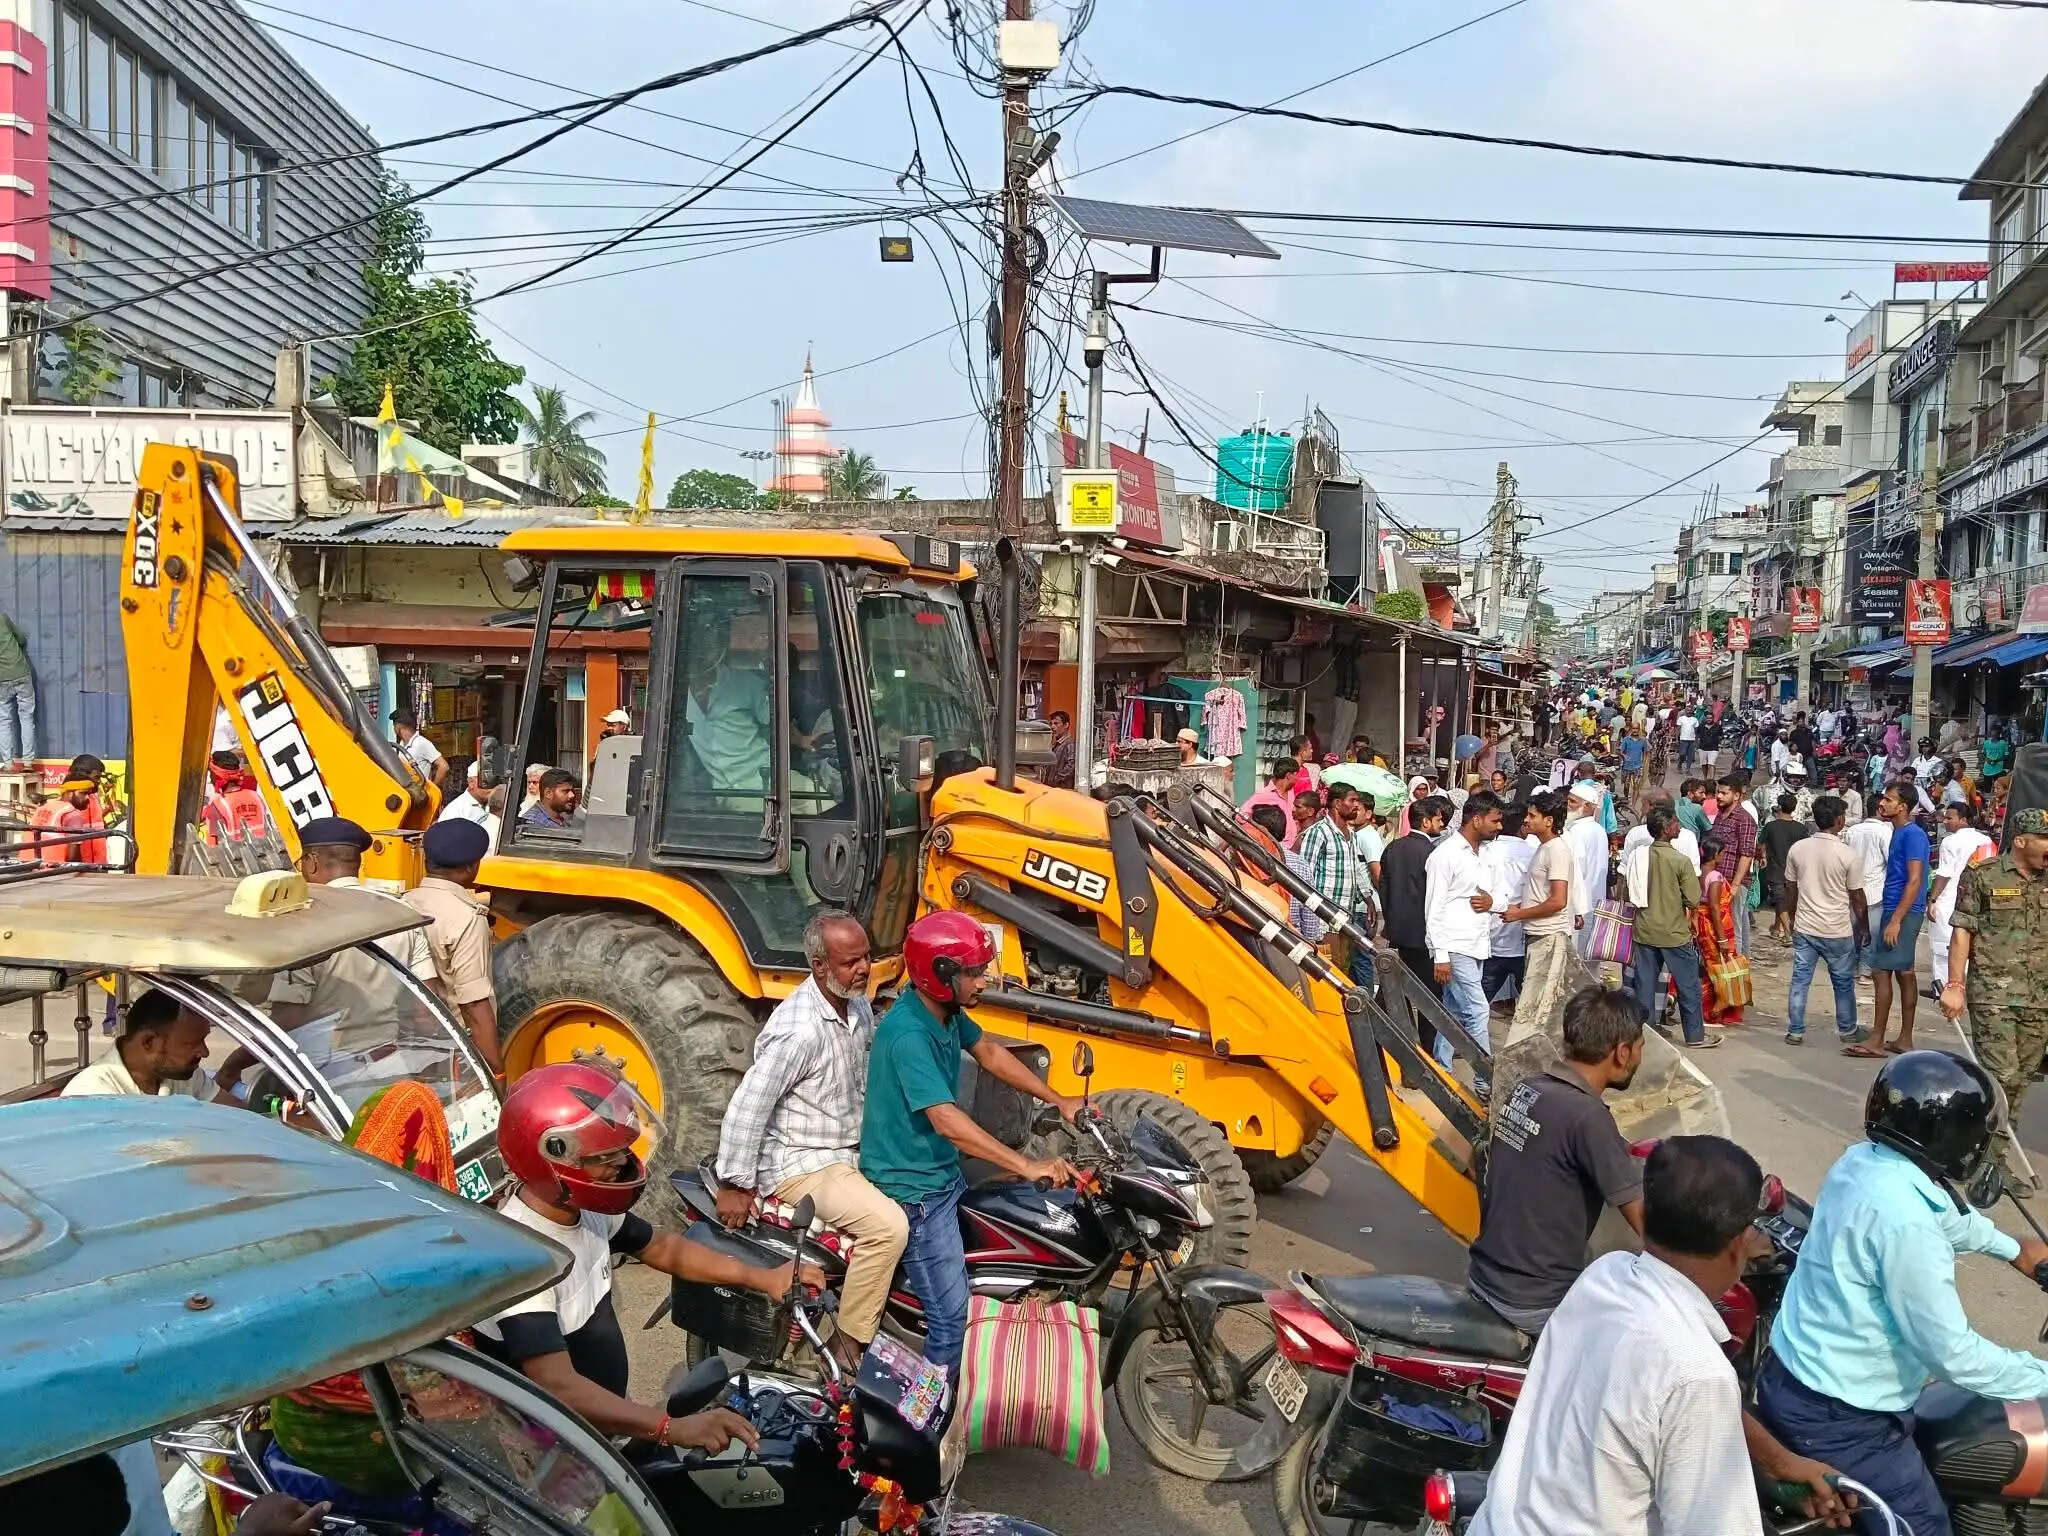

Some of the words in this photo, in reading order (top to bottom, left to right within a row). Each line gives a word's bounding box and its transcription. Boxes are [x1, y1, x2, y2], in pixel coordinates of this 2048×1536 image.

[1120, 500, 1158, 530] RONTLINE
[263, 681, 280, 701] JCB
[1024, 855, 1107, 901] JCB
[1268, 1372, 1297, 1416] 9850
